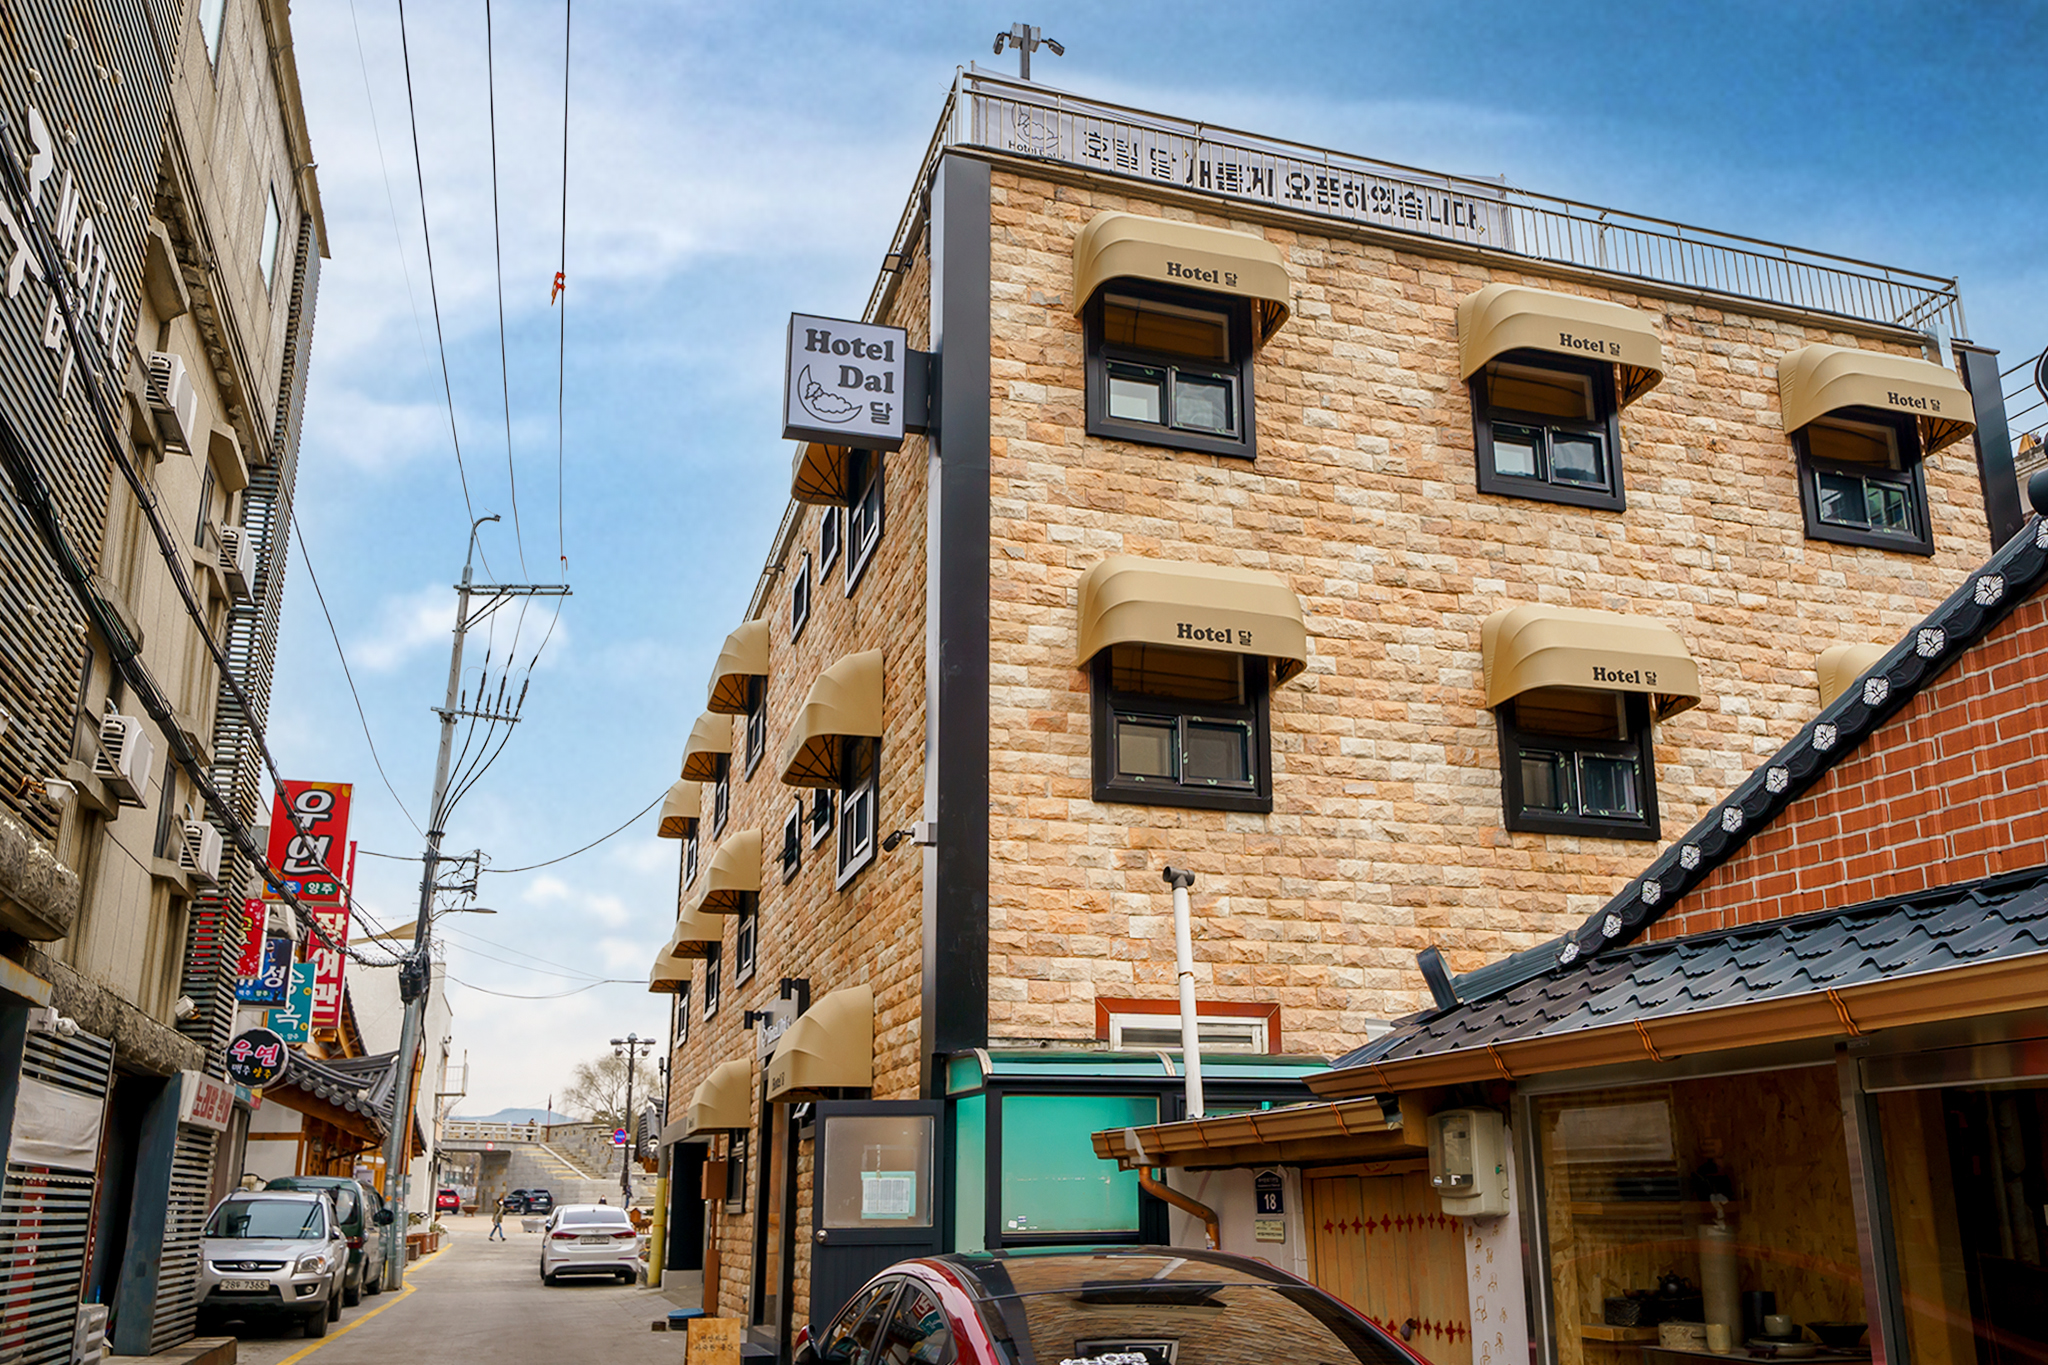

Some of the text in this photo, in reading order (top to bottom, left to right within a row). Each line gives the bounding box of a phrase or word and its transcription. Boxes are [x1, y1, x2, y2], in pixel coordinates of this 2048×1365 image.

[1082, 131, 1138, 171] 호텔
[1185, 157, 1274, 197] 새롭게
[1284, 172, 1478, 230] 오픈하였습니다
[53, 168, 124, 370] MOTEL
[1166, 261, 1238, 287] Hotel 달
[804, 328, 895, 363] Hotel
[1559, 333, 1621, 357] Hotel 달
[837, 364, 895, 394] Dal
[870, 401, 893, 425] 달
[1887, 391, 1941, 412] Hotel 달
[1177, 623, 1253, 646] Hotel 달
[1592, 667, 1657, 686] Hotel 달
[307, 882, 333, 894] 양주
[230, 1039, 280, 1067] 우연
[231, 1064, 272, 1079] 맥주 양주
[1264, 1193, 1277, 1210] 18
